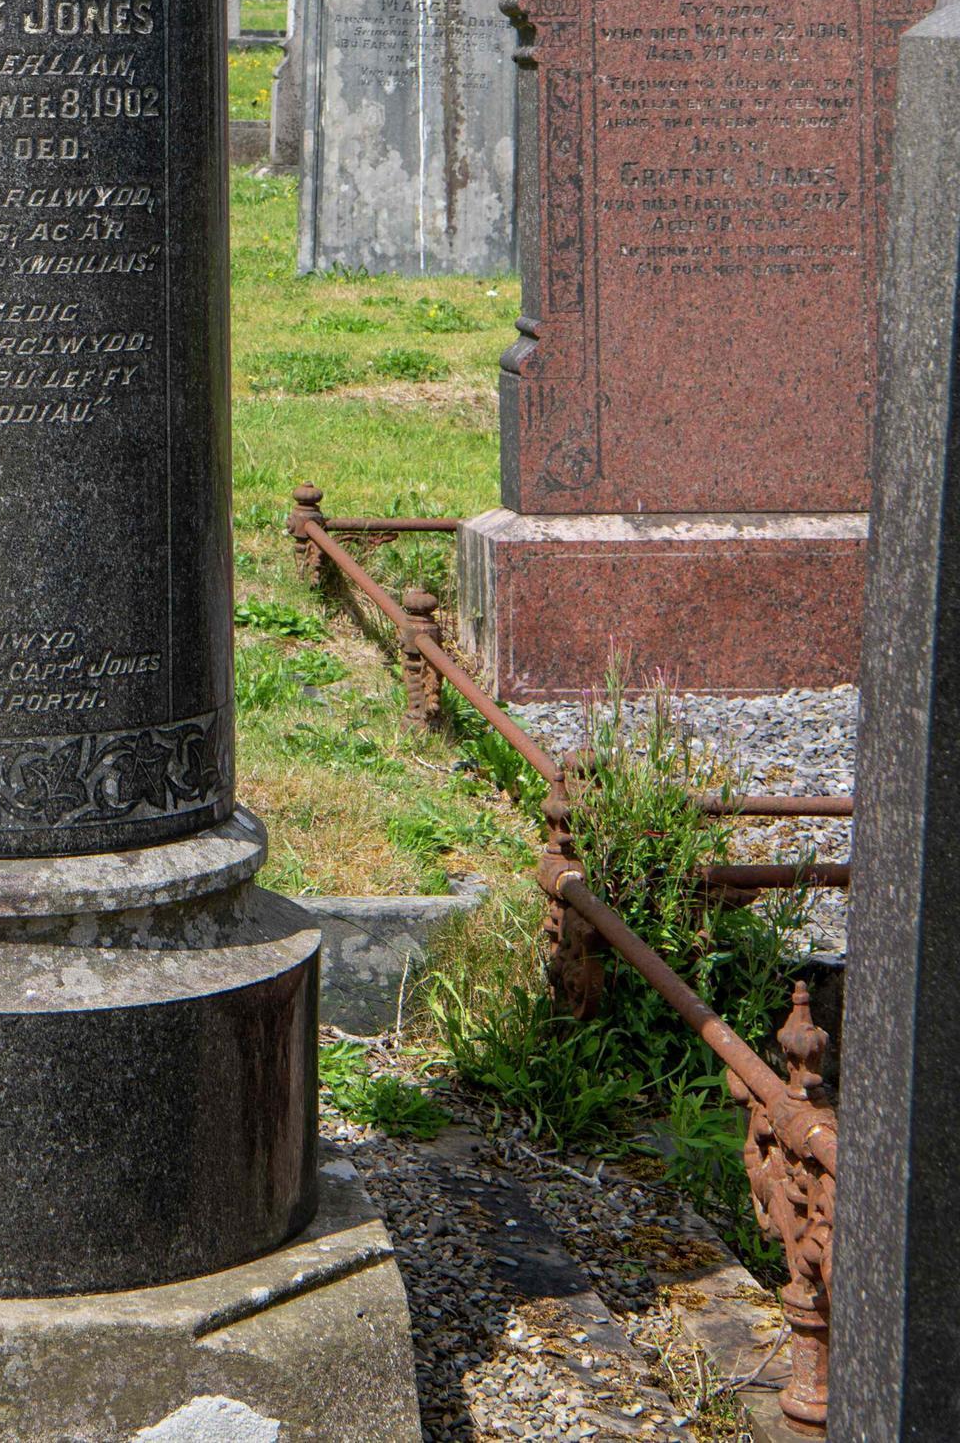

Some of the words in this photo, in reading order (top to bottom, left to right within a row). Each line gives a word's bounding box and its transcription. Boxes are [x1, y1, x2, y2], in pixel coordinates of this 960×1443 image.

[26, 222, 71, 242] AC
[100, 364, 140, 388] FY
[89, 649, 163, 679] JONES
